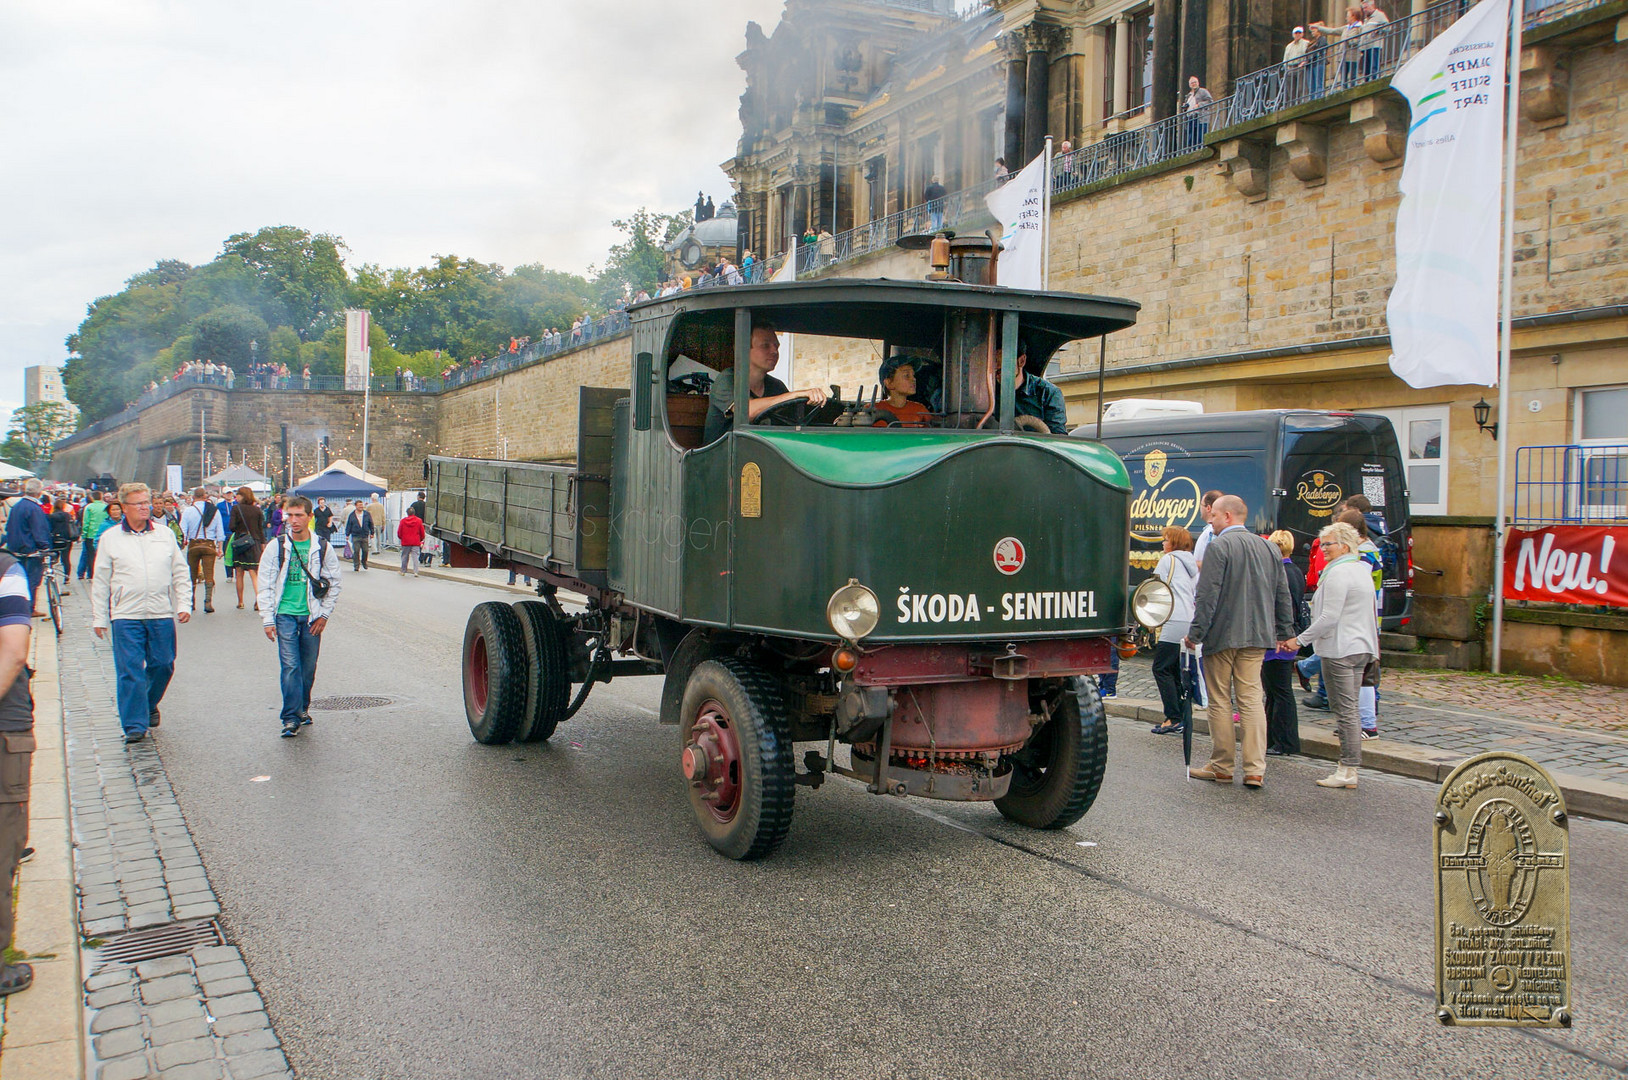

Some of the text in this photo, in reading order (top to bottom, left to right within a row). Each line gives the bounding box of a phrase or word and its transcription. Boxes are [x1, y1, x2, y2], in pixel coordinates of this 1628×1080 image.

[1296, 481, 1343, 508] Radeberger
[1514, 533, 1616, 595] Neu!
[897, 586, 981, 623] ŠKODA
[1001, 590, 1098, 621] SENTINEL
